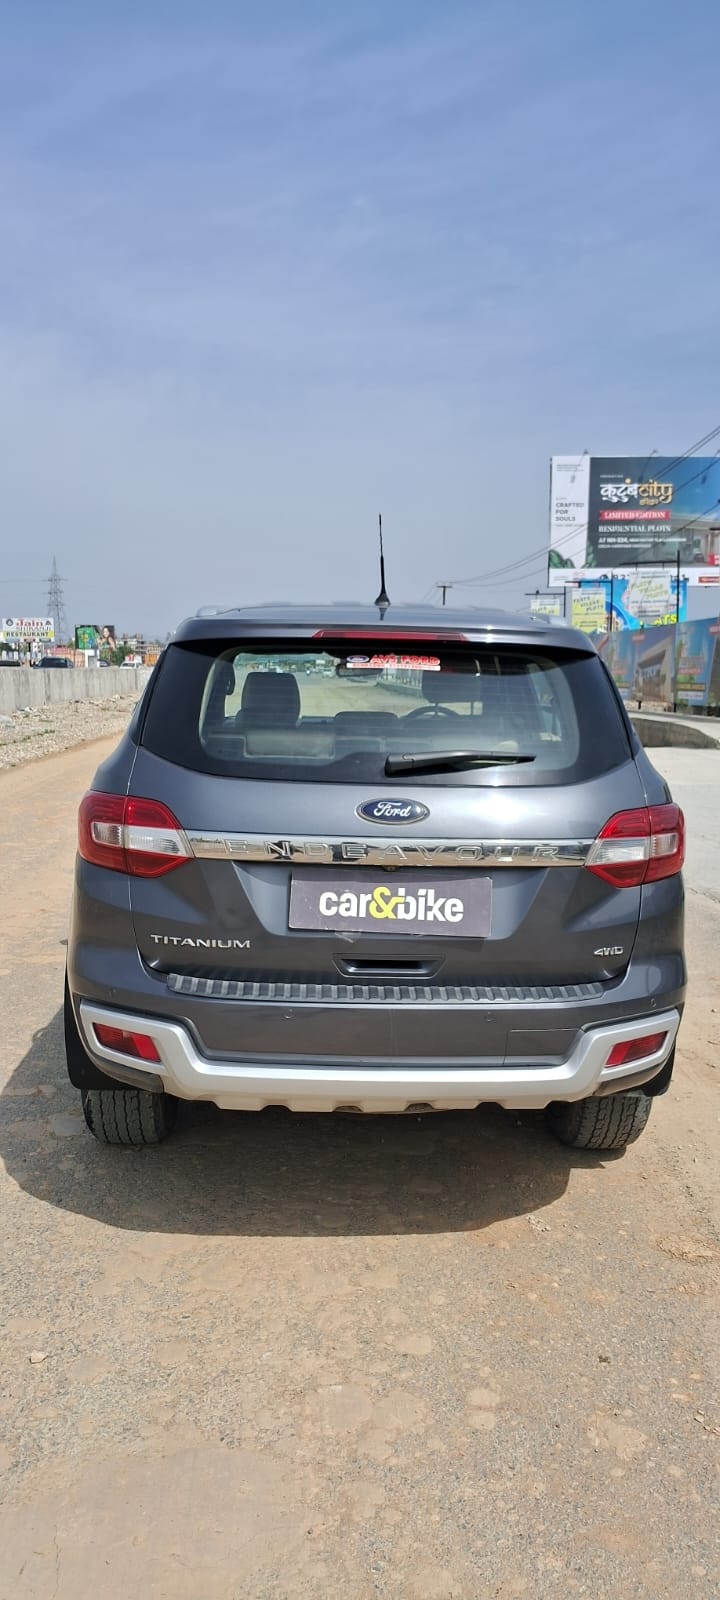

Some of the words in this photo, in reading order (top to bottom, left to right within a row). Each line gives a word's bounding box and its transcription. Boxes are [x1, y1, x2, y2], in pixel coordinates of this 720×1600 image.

[373, 801, 411, 817] Ford
[223, 839, 559, 862] ENDEAVOUR
[319, 886, 464, 923] car&bike
[150, 934, 251, 949] TITANIUM
[593, 946, 624, 957] 4WD
